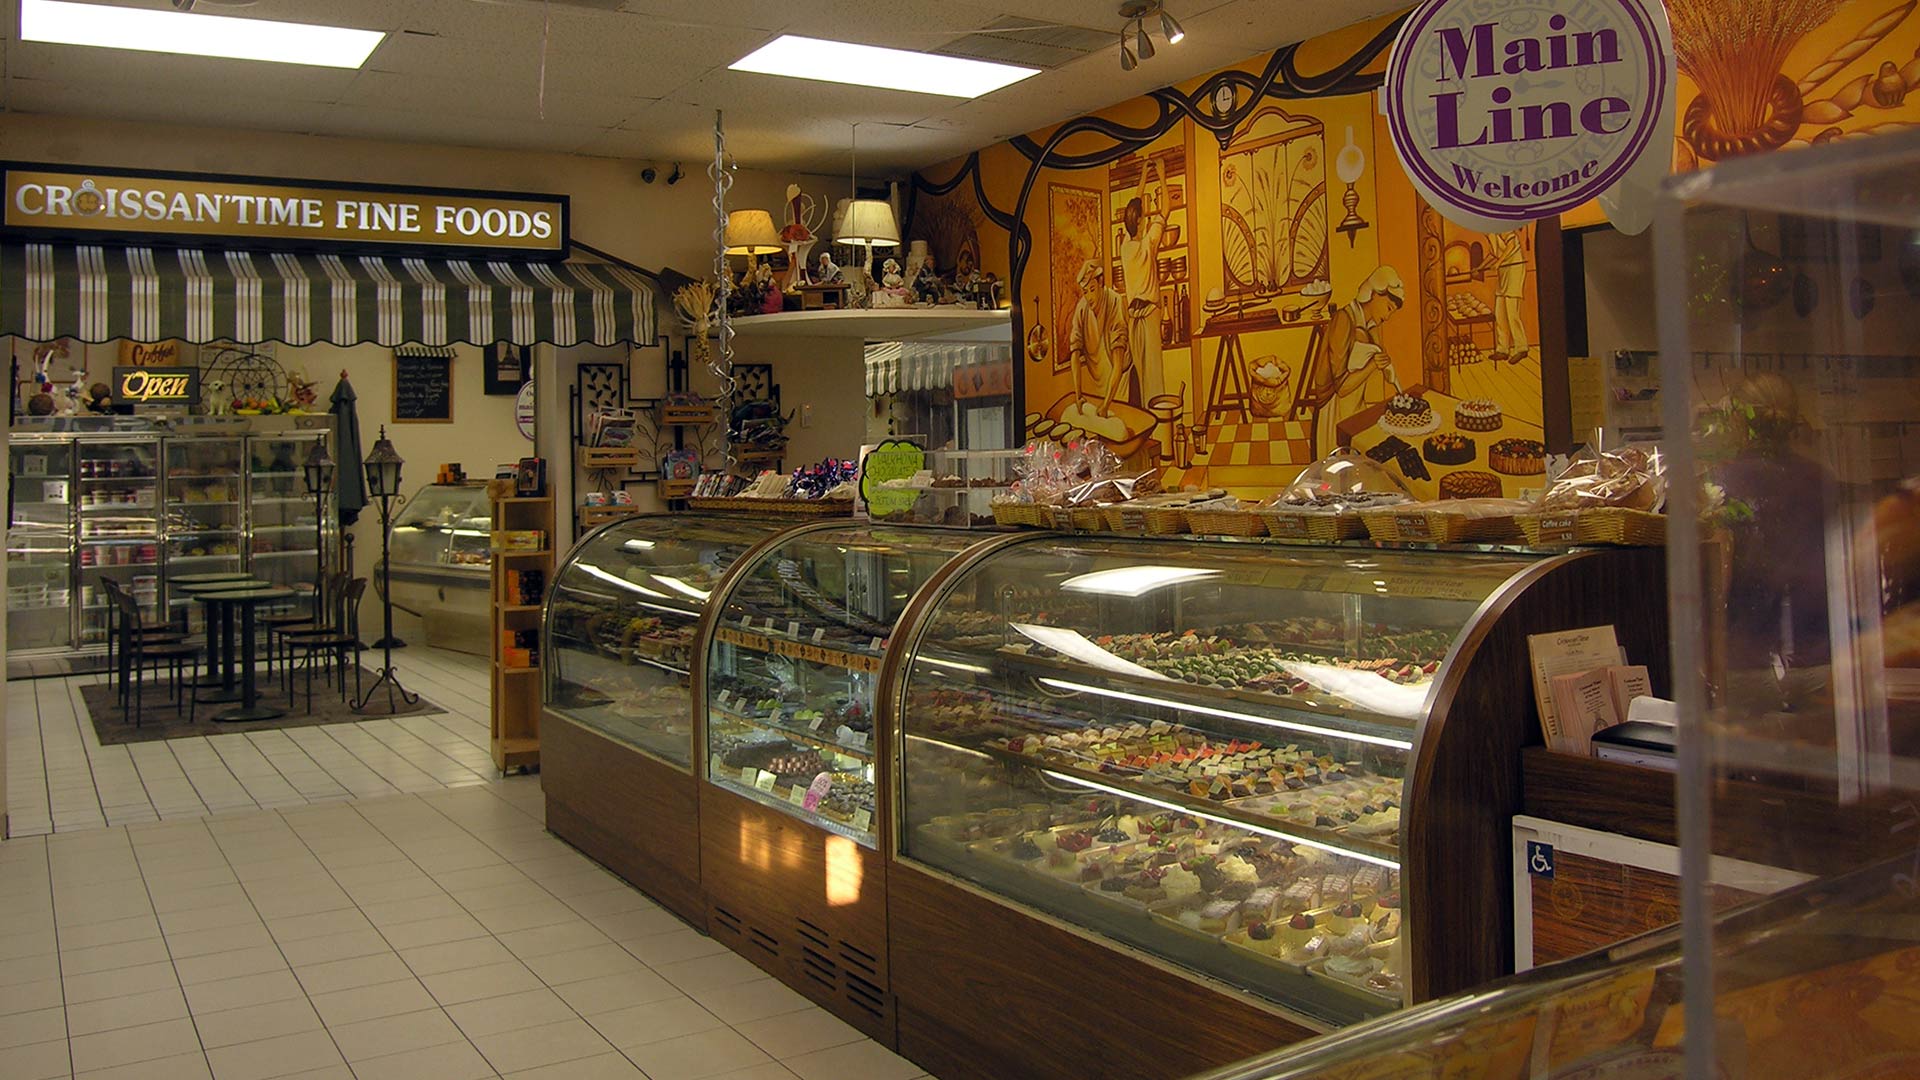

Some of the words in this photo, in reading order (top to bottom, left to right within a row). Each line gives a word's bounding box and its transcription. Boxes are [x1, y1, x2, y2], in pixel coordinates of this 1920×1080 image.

[1434, 14, 1623, 82] Main
[1429, 87, 1631, 150] Line
[1450, 159, 1599, 199] Welcome
[16, 180, 324, 228] CROISSAN'TIME
[336, 200, 421, 232] FINE
[435, 206, 552, 239] FOODS
[122, 370, 189, 402] Open
[1542, 520, 1558, 528] Coffee
[1559, 520, 1572, 528] cake
